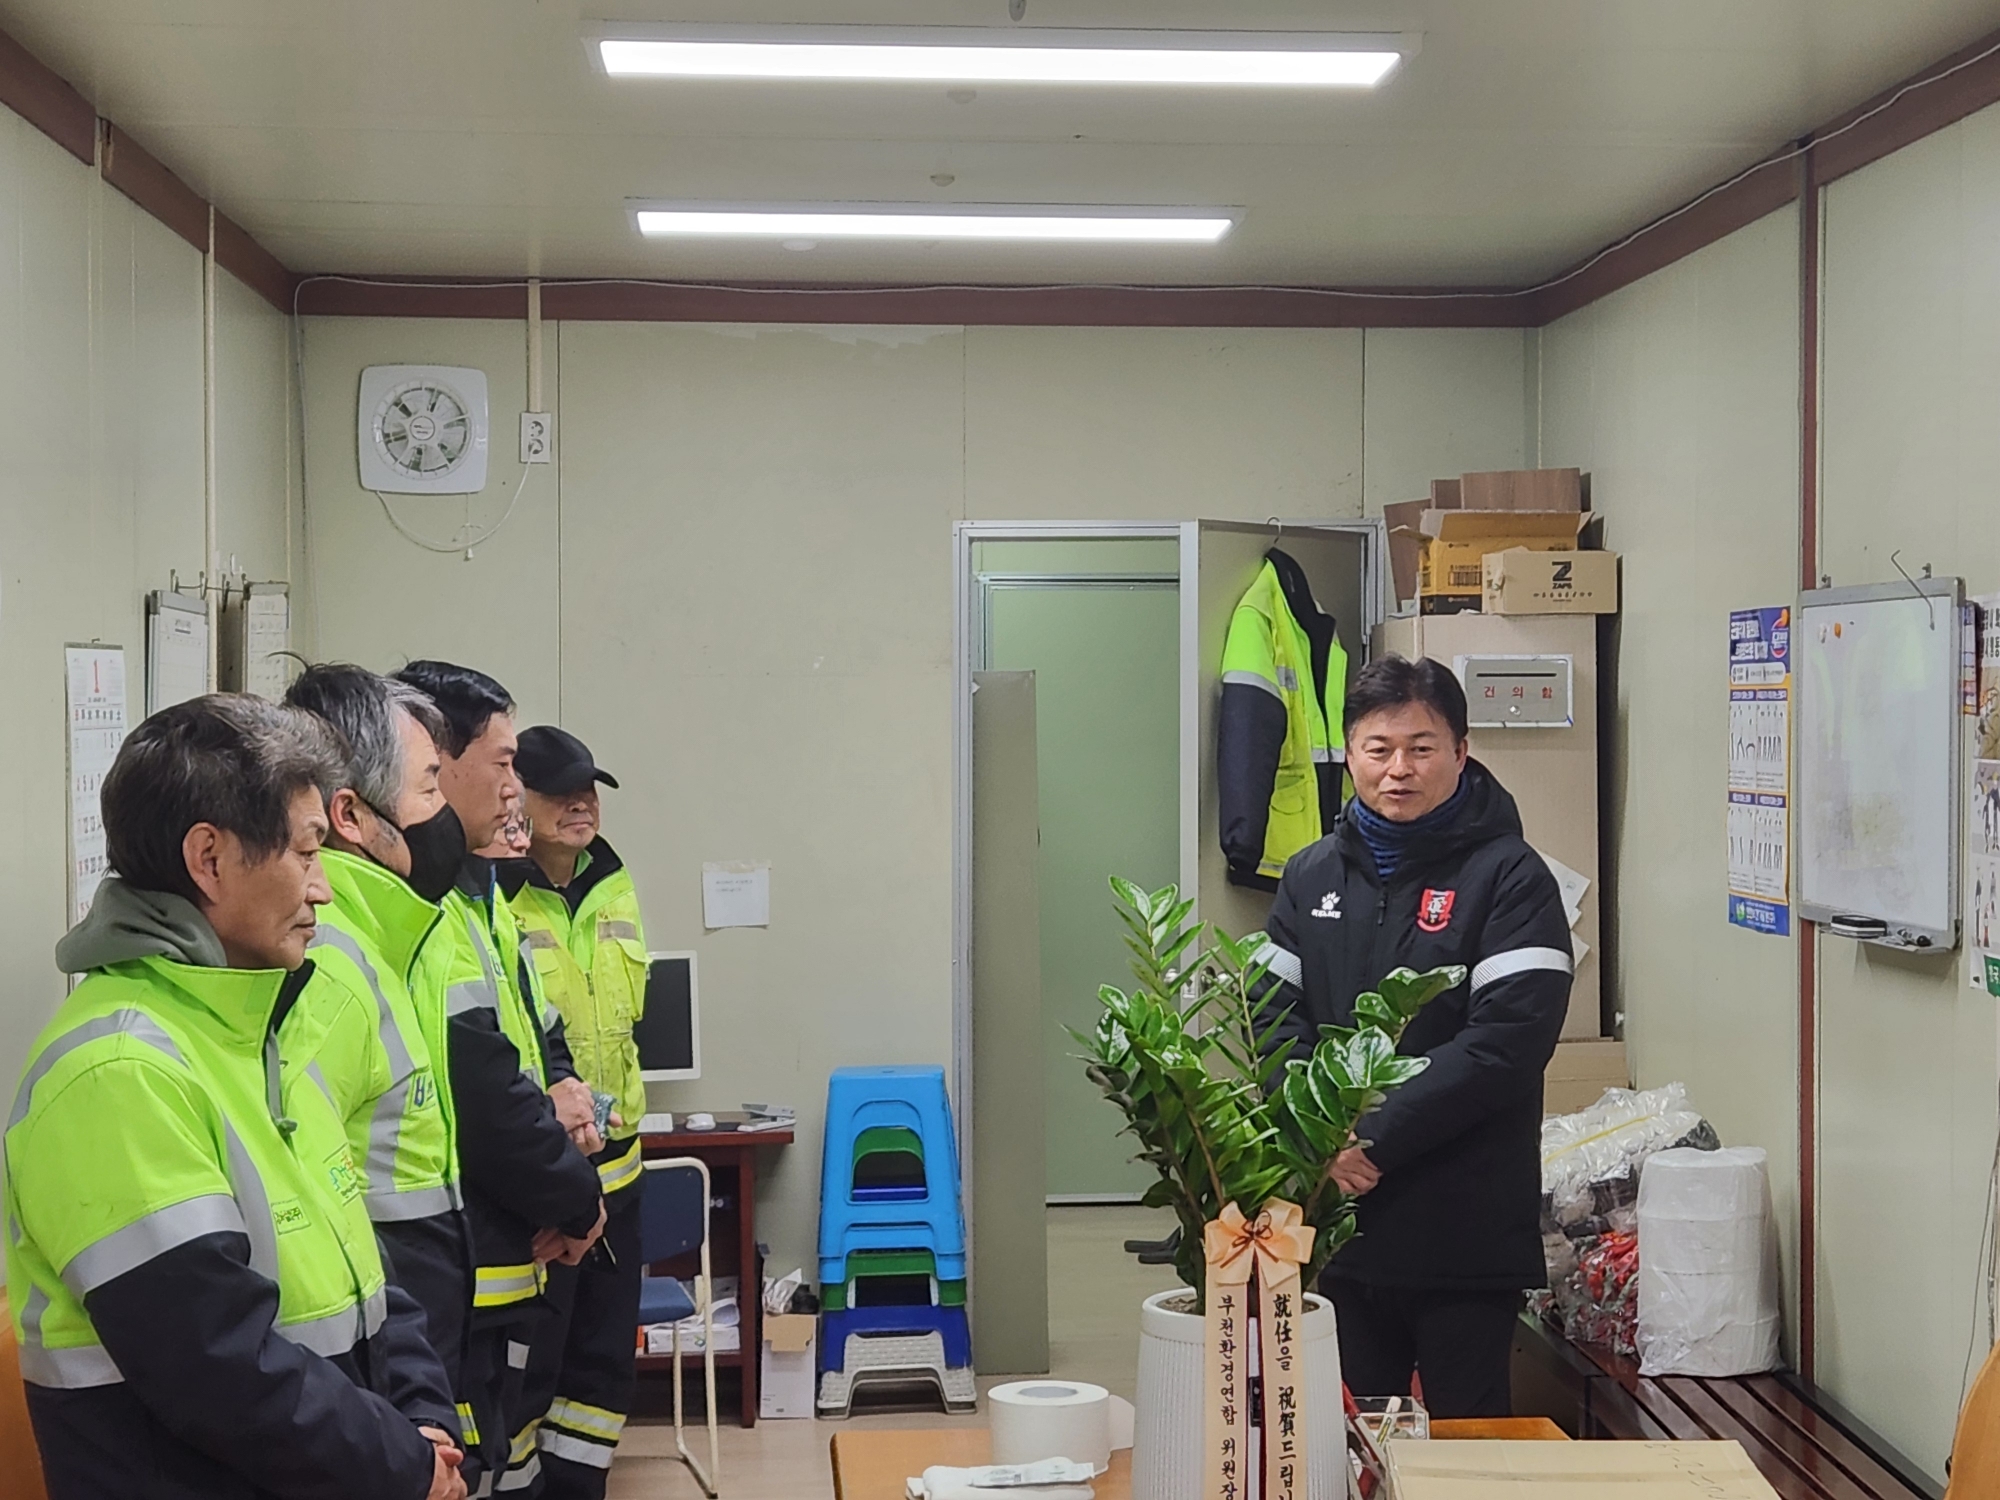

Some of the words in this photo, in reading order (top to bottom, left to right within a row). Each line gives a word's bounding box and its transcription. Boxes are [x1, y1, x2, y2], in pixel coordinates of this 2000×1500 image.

[1552, 561, 1572, 581] Z
[1217, 1294, 1238, 1426] 부천환경연합
[1219, 1437, 1238, 1500] 위원장
